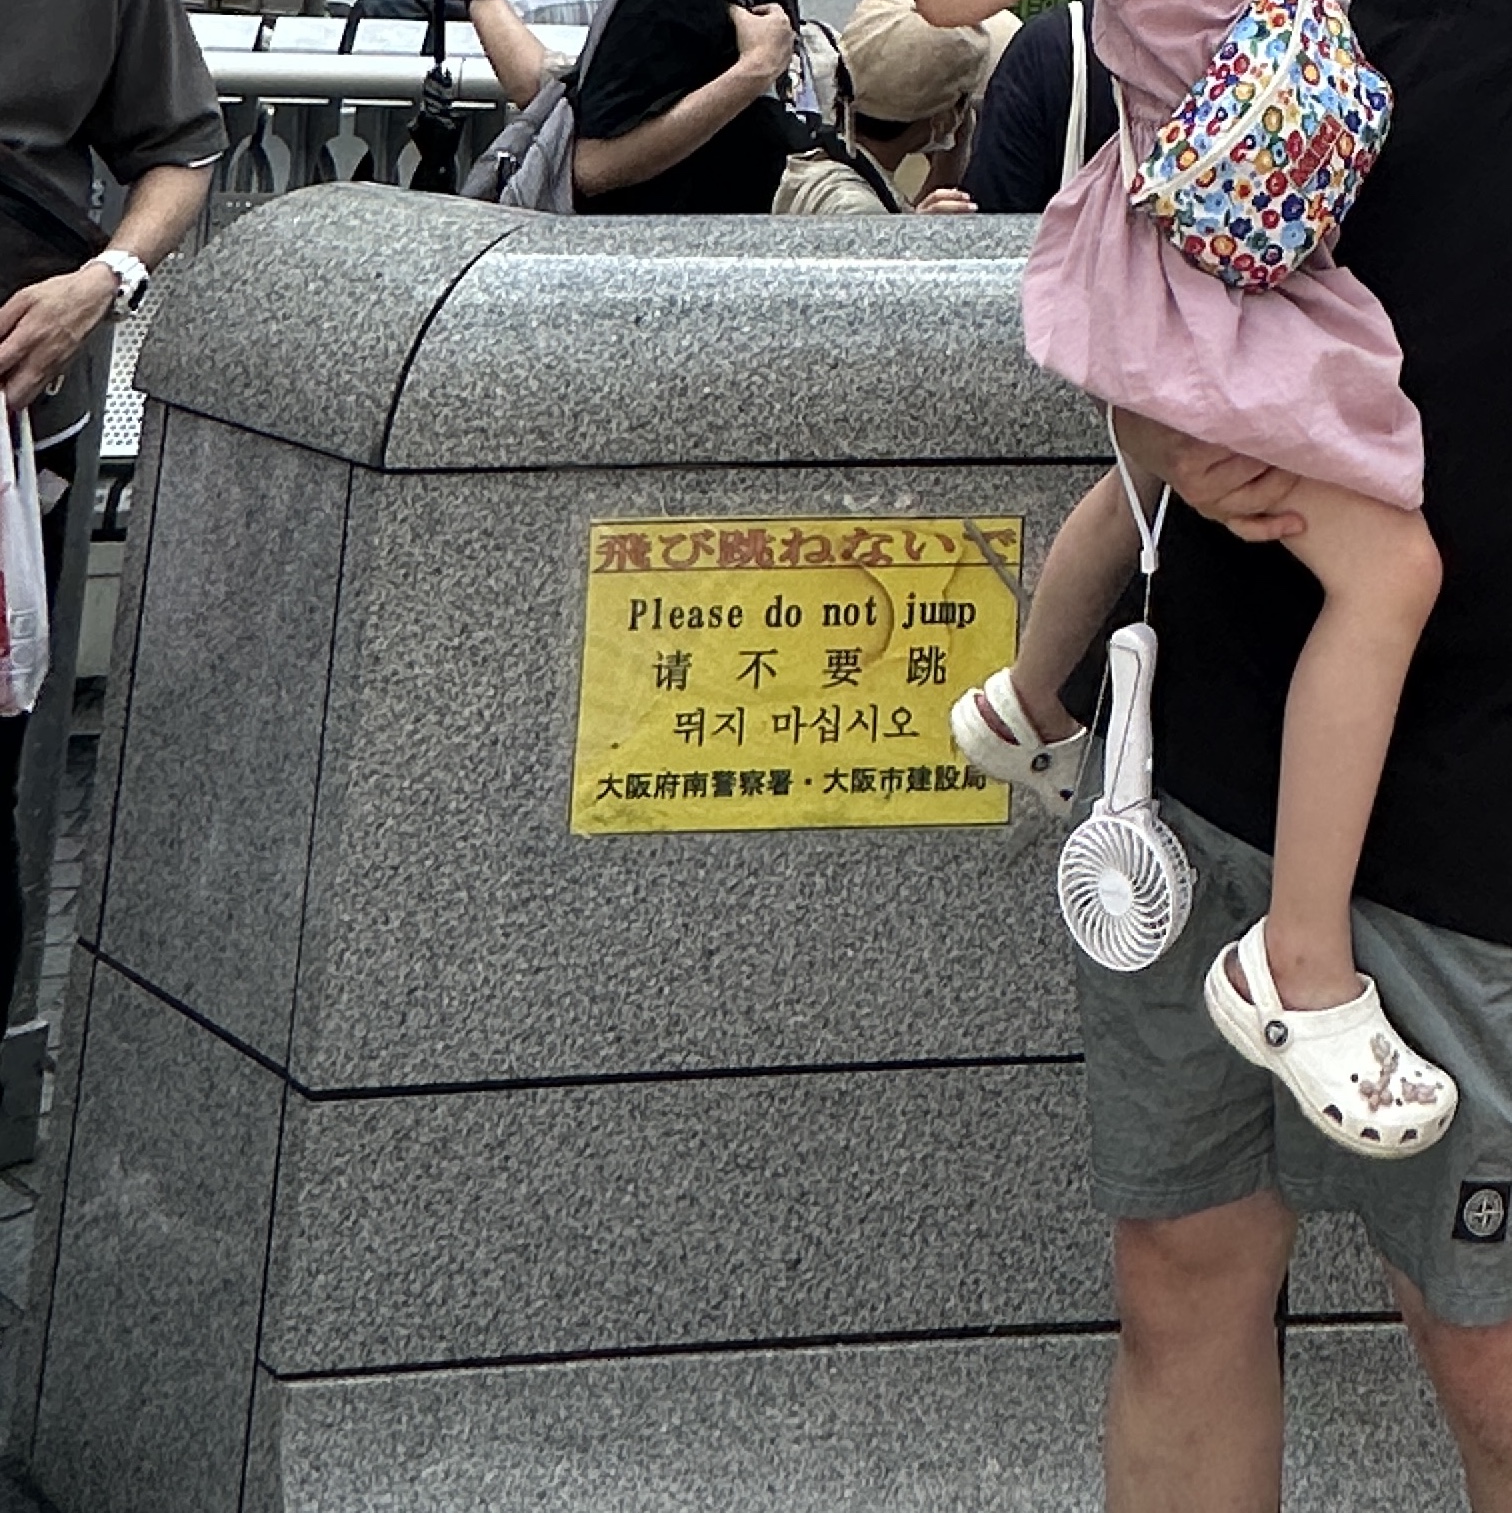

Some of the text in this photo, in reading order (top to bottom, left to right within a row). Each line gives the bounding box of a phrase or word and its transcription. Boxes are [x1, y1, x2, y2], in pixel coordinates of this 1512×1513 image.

[628, 592, 978, 632] Please do not jump
[771, 703, 920, 745] 마십시오
